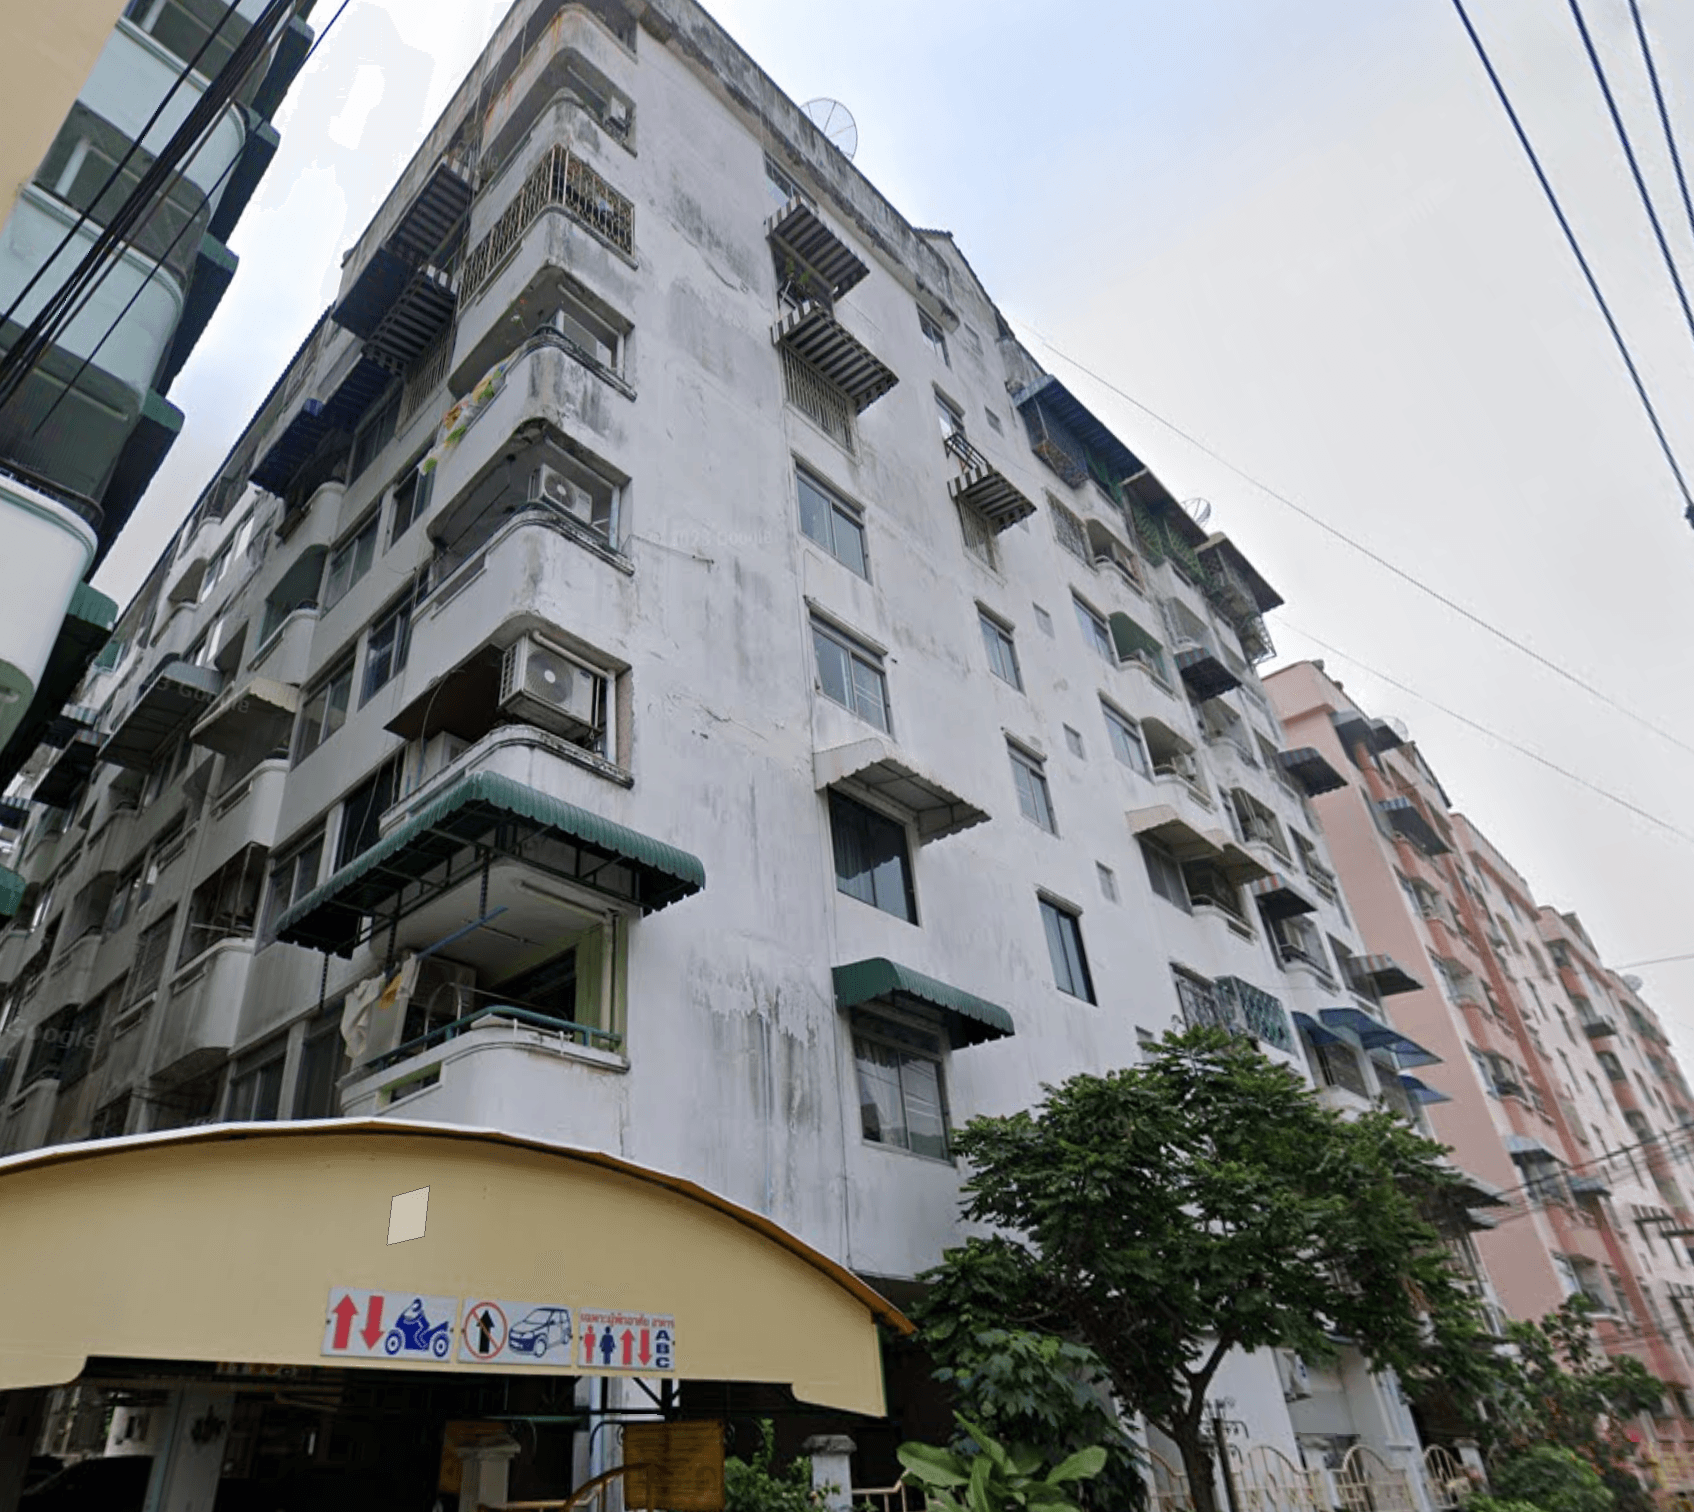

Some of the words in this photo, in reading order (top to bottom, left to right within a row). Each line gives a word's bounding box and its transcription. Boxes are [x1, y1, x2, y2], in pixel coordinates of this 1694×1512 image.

[655, 1329, 670, 1341] A
[656, 1342, 670, 1354] B
[655, 1356, 670, 1368] C
